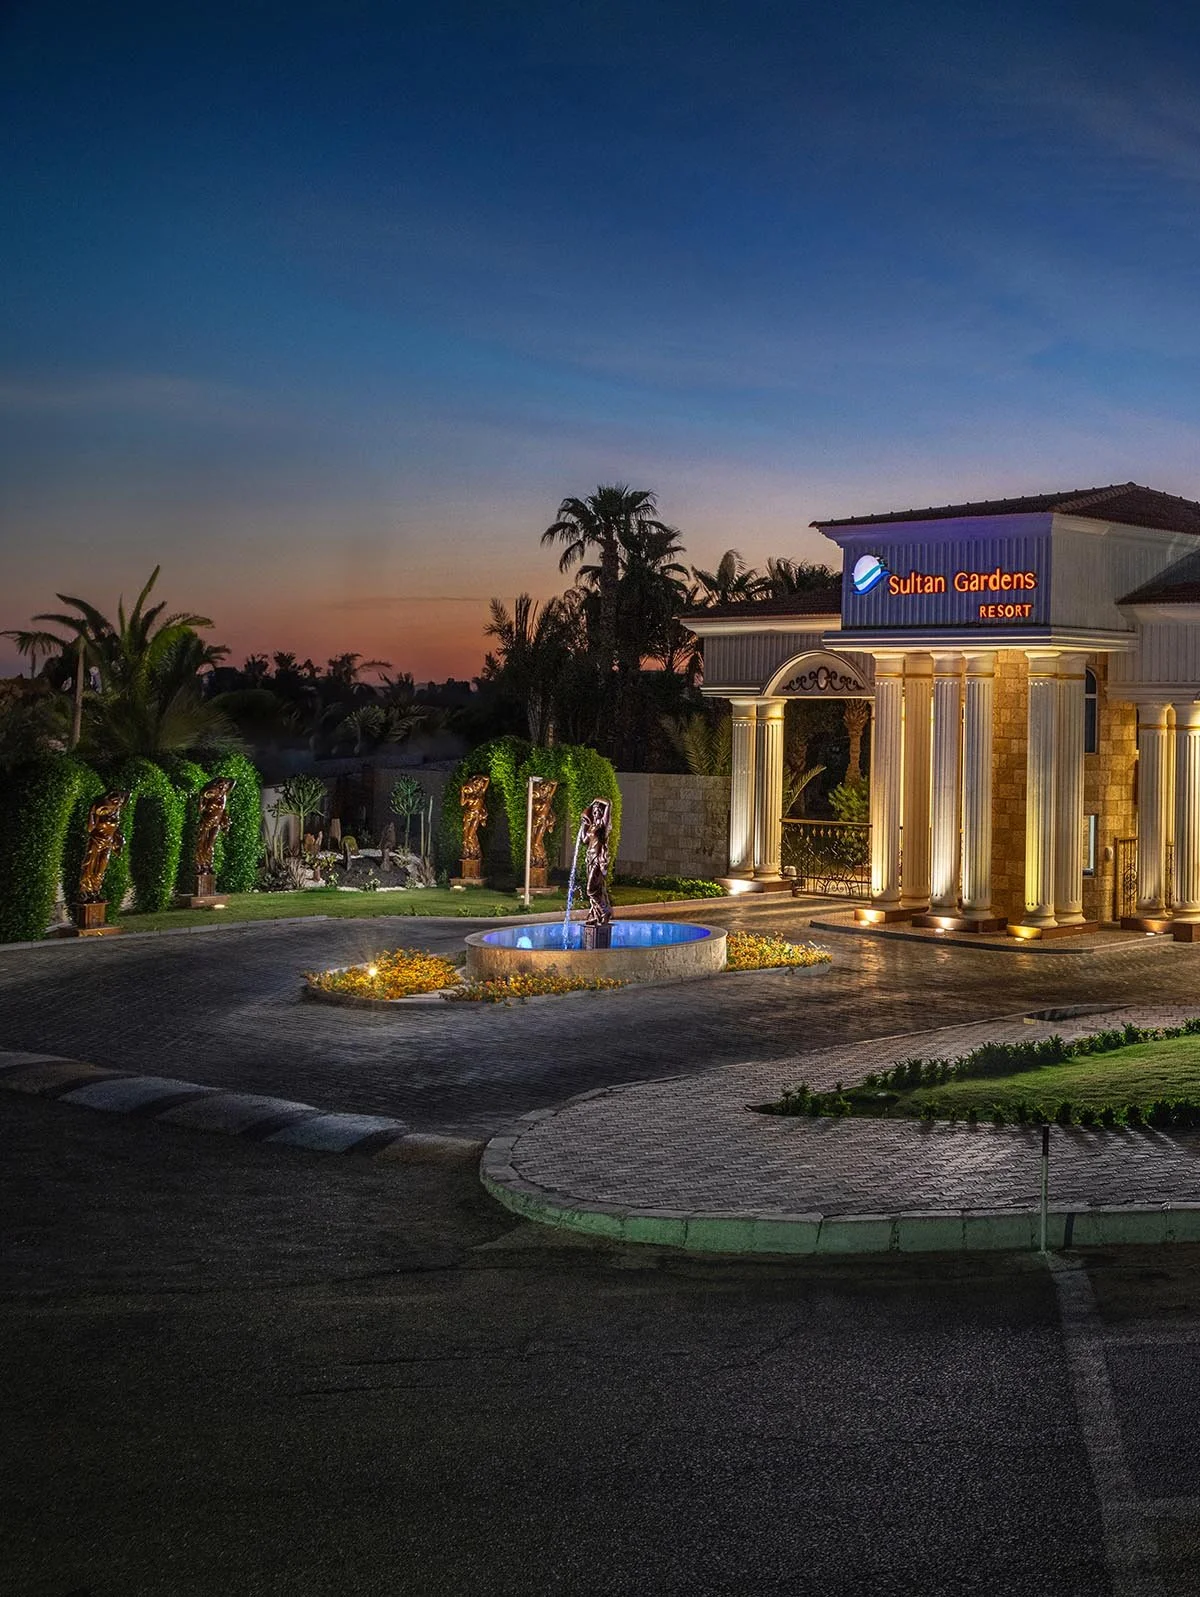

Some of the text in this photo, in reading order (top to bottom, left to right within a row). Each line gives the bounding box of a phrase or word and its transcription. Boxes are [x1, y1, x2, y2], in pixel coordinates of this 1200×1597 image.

[889, 569, 1036, 595] Sultan Gardens
[979, 604, 1032, 618] RESORT
